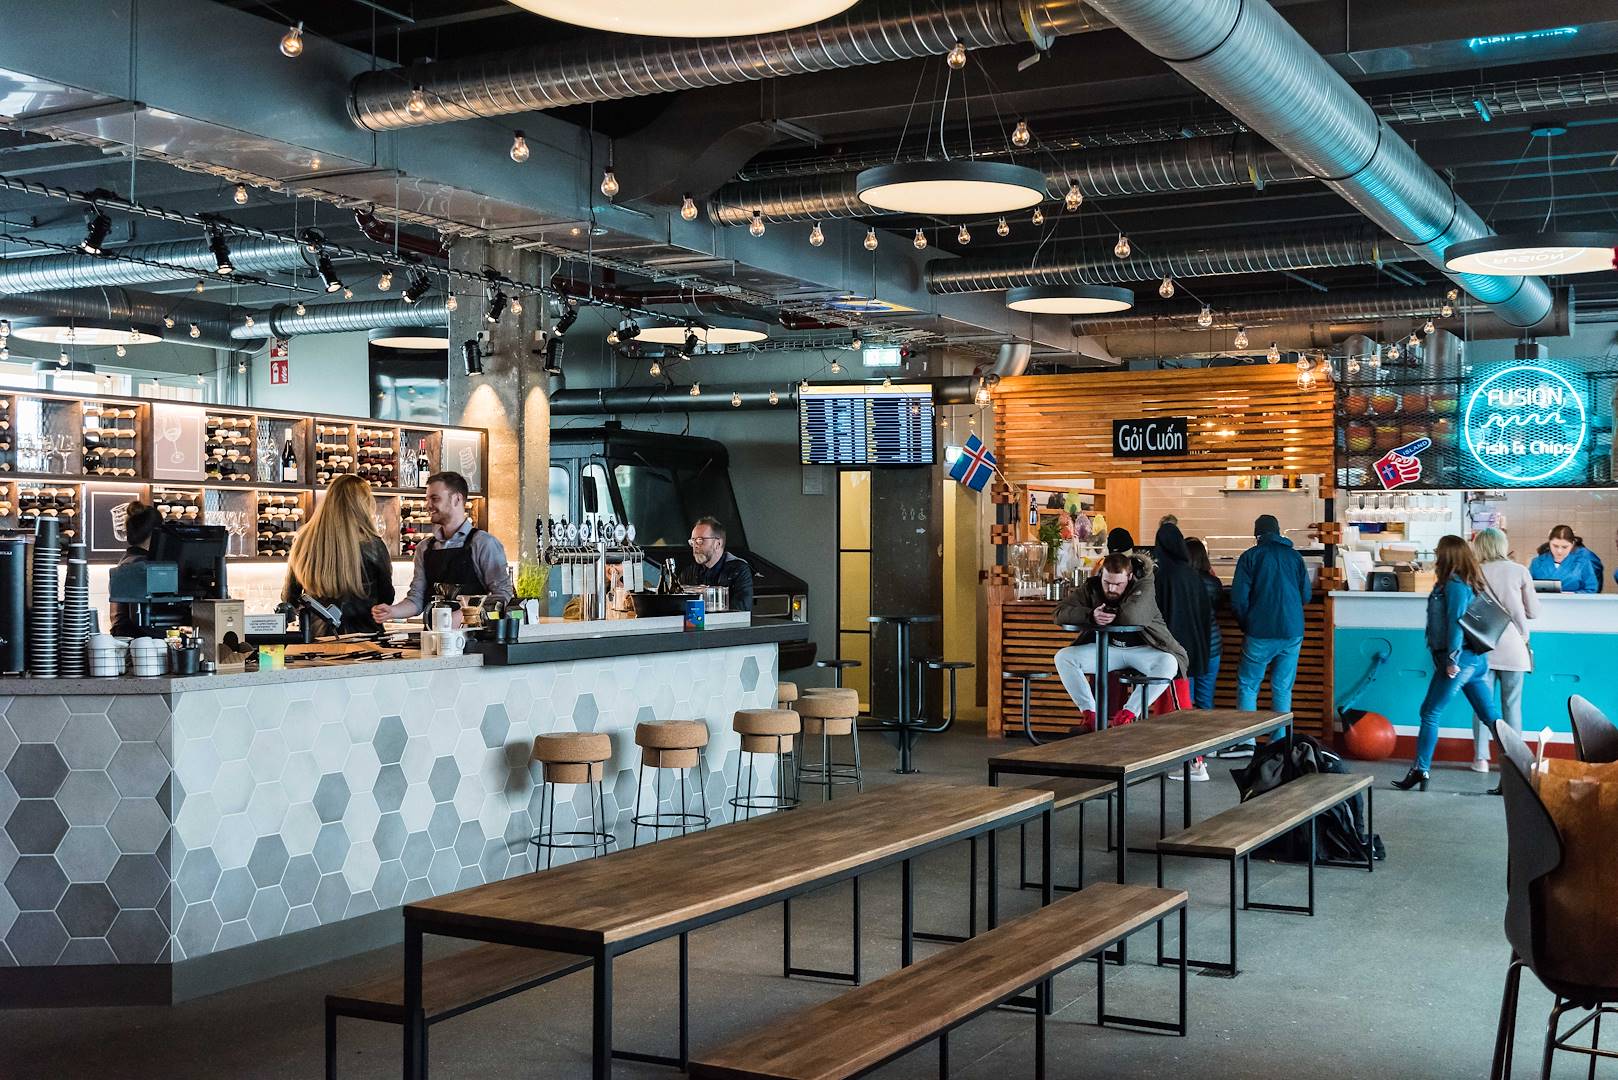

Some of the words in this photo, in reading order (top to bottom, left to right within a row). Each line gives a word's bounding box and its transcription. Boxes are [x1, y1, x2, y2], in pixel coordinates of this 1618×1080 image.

[1487, 386, 1563, 407] FUSION
[1119, 425, 1143, 452] Gỏi
[1146, 424, 1183, 451] Cuốn
[1476, 441, 1509, 455] Fish
[1512, 441, 1525, 454] &
[1530, 440, 1573, 456] Chips
